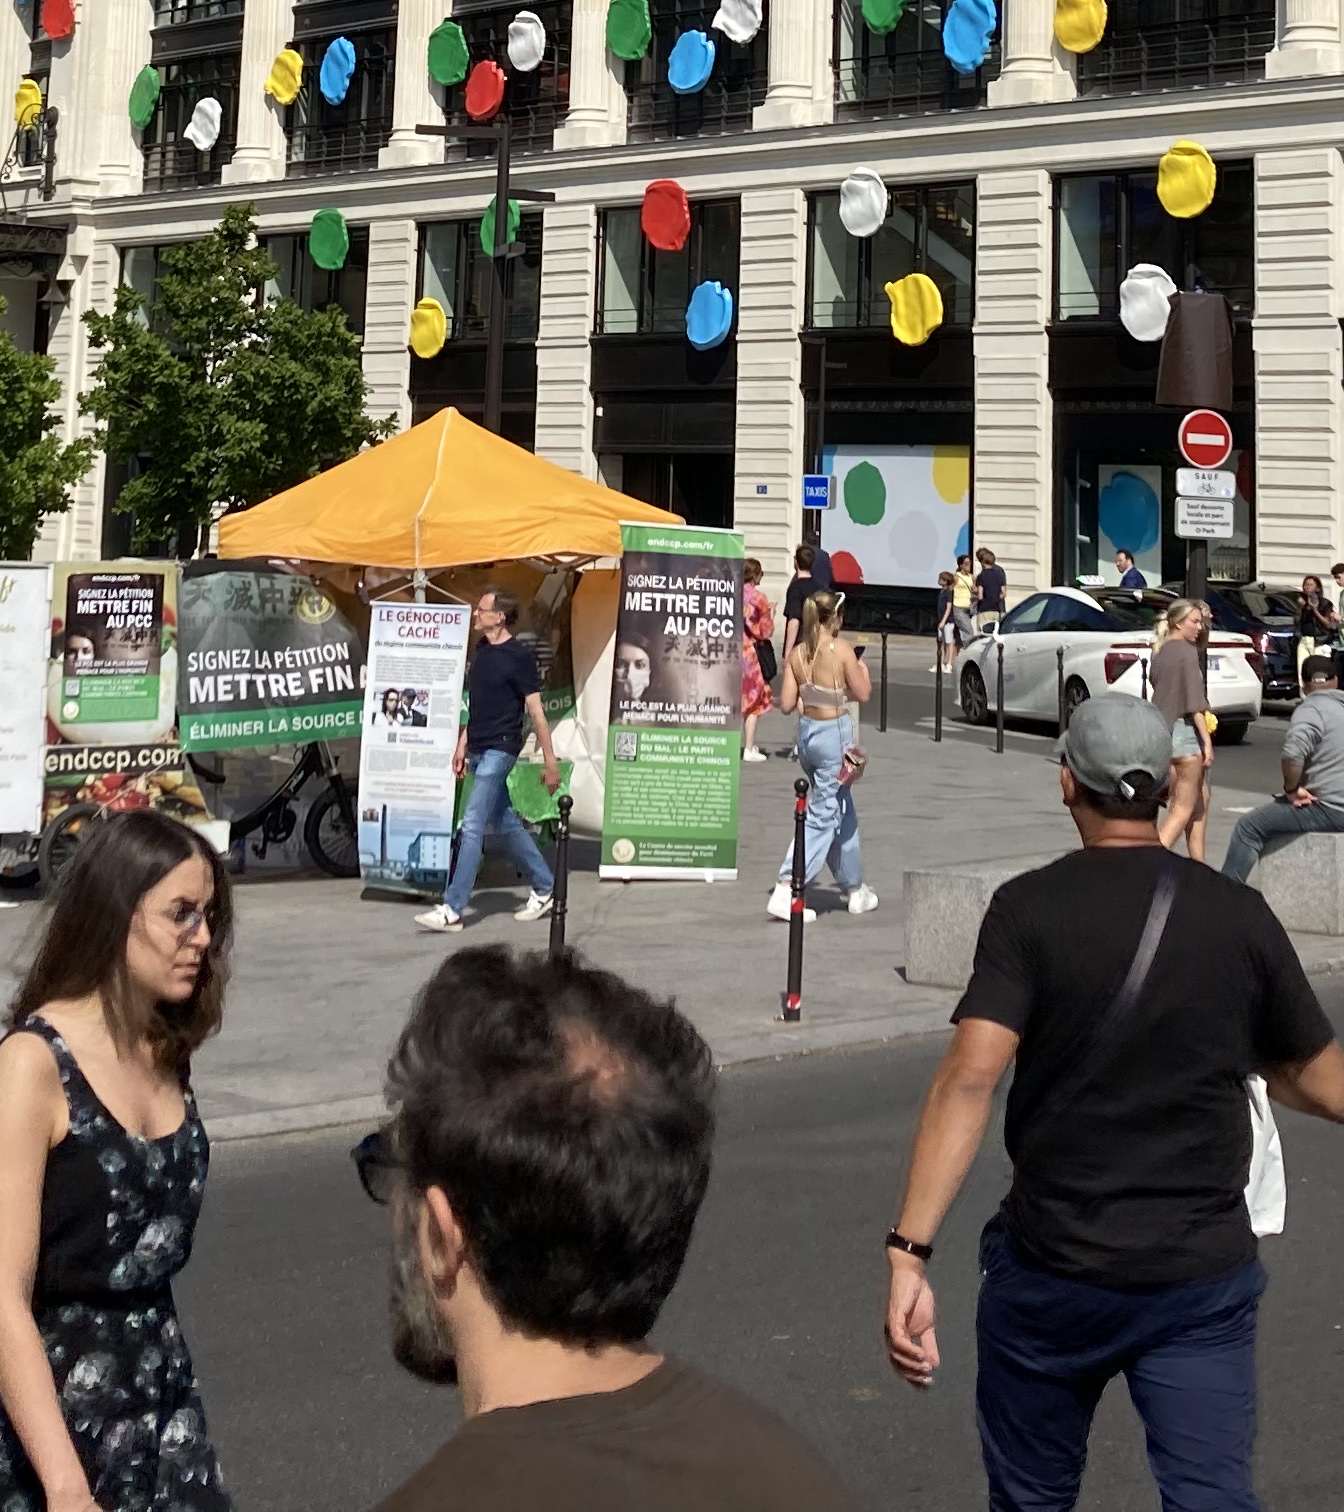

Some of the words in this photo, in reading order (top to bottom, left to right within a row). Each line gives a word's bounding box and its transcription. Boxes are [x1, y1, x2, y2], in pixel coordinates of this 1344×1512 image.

[1195, 472, 1218, 480] SAUF
[805, 486, 828, 497] TAXIS
[647, 538, 714, 551] endccp.com/fr
[627, 574, 667, 589] SIGNEZ
[668, 577, 684, 590] LA
[686, 575, 735, 593] PÉTITION
[78, 589, 106, 600] SIGNEZ
[107, 588, 119, 599] LA
[119, 587, 154, 599] PÉTITION
[77, 600, 131, 614] METTRE
[131, 599, 153, 613] FIN
[625, 592, 700, 614] METTRE
[705, 595, 734, 616] FIN
[106, 615, 126, 628] AU
[127, 614, 153, 628] PCC
[379, 610, 393, 622] LE
[397, 608, 462, 625] GÉNOCIDE
[398, 626, 440, 639] CACHÉ
[664, 616, 690, 635] AU
[695, 618, 734, 638] PCC
[188, 649, 251, 672] SIGNEZ
[255, 649, 272, 669] LA
[274, 641, 350, 669] PÉTITION
[189, 672, 305, 704] METTRE
[308, 664, 355, 693] FIN
[620, 700, 629, 709] LE
[631, 701, 647, 710] PCC
[649, 701, 664, 711] EST
[665, 702, 676, 711] LA
[677, 703, 697, 713] PLUS
[699, 704, 730, 715] GRANDE
[623, 711, 655, 721] MENACE
[657, 713, 679, 723] POUR
[681, 713, 726, 725] L'HUMANITÉ
[189, 720, 264, 740] ÉLIMINER
[268, 719, 289, 733] LA
[292, 711, 355, 731] SOURCE
[641, 733, 679, 744] ÉLIMINER
[681, 735, 692, 744] LA
[693, 735, 727, 745] SOURCE
[640, 744, 652, 752] DU
[654, 745, 672, 753] MAL
[678, 745, 689, 754] LE
[690, 745, 714, 755] PARTI
[640, 753, 695, 764] COMMUNISTE
[697, 756, 731, 766] CHINOIS
